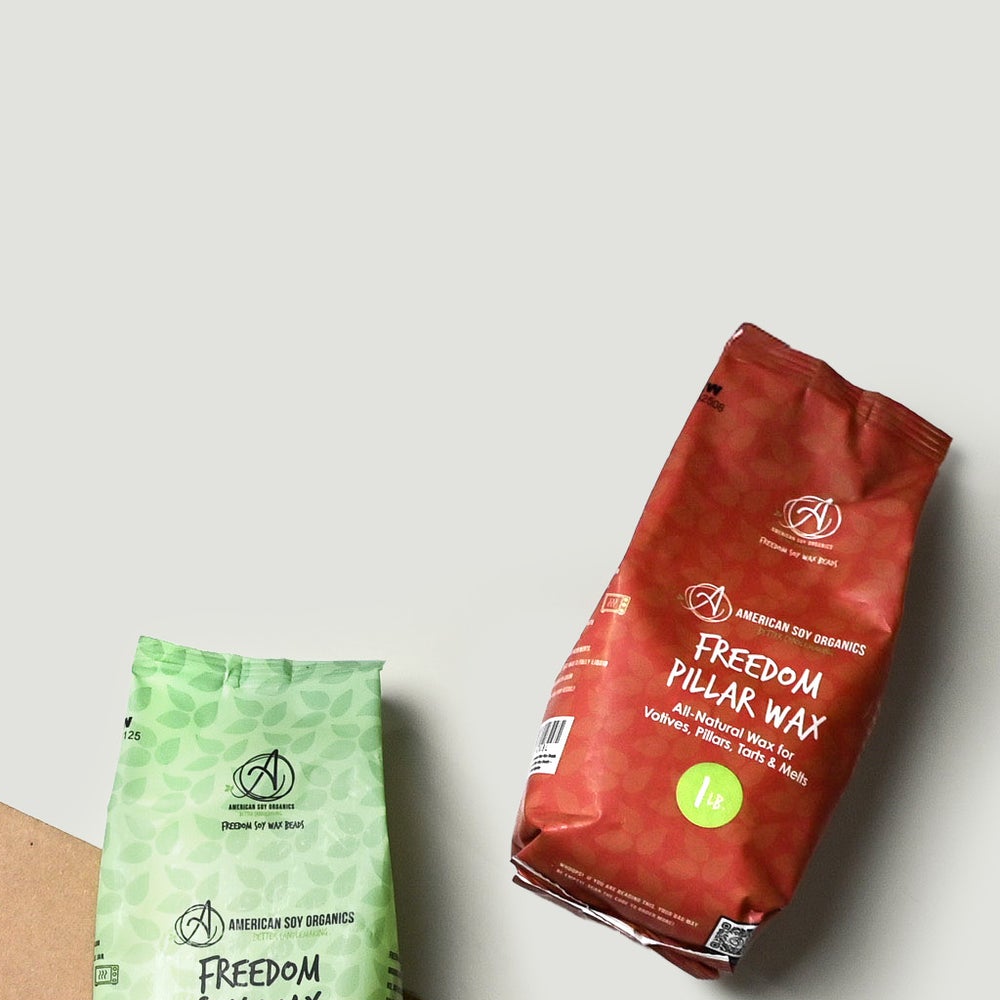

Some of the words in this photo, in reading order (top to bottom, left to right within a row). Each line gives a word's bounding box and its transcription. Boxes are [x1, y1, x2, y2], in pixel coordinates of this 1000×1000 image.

[759, 536, 787, 554] FREEDOM
[735, 608, 790, 633] AMERICAN
[791, 625, 813, 640] SOY
[813, 634, 867, 657] ORGANICS
[693, 632, 823, 699] FREEDOM
[666, 657, 756, 718] PILLAR
[764, 698, 828, 741] WAX
[644, 706, 691, 735] Votives,
[694, 726, 733, 752] Pillars,
[737, 743, 766, 764] Tarts
[767, 756, 776, 769] &
[778, 762, 808, 787] Melts
[672, 702, 744, 739] All-Natural
[747, 731, 775, 752] Wax
[776, 744, 795, 760] for
[694, 775, 711, 808] 1
[221, 820, 252, 831] FREEDOM
[254, 820, 266, 830] SOY
[268, 821, 283, 830] WAX
[284, 820, 305, 830] BEADS
[228, 917, 281, 931] AMERICAN
[284, 915, 303, 929] SOY
[306, 911, 355, 928] ORGANICS
[198, 953, 320, 994] FREEDOM
